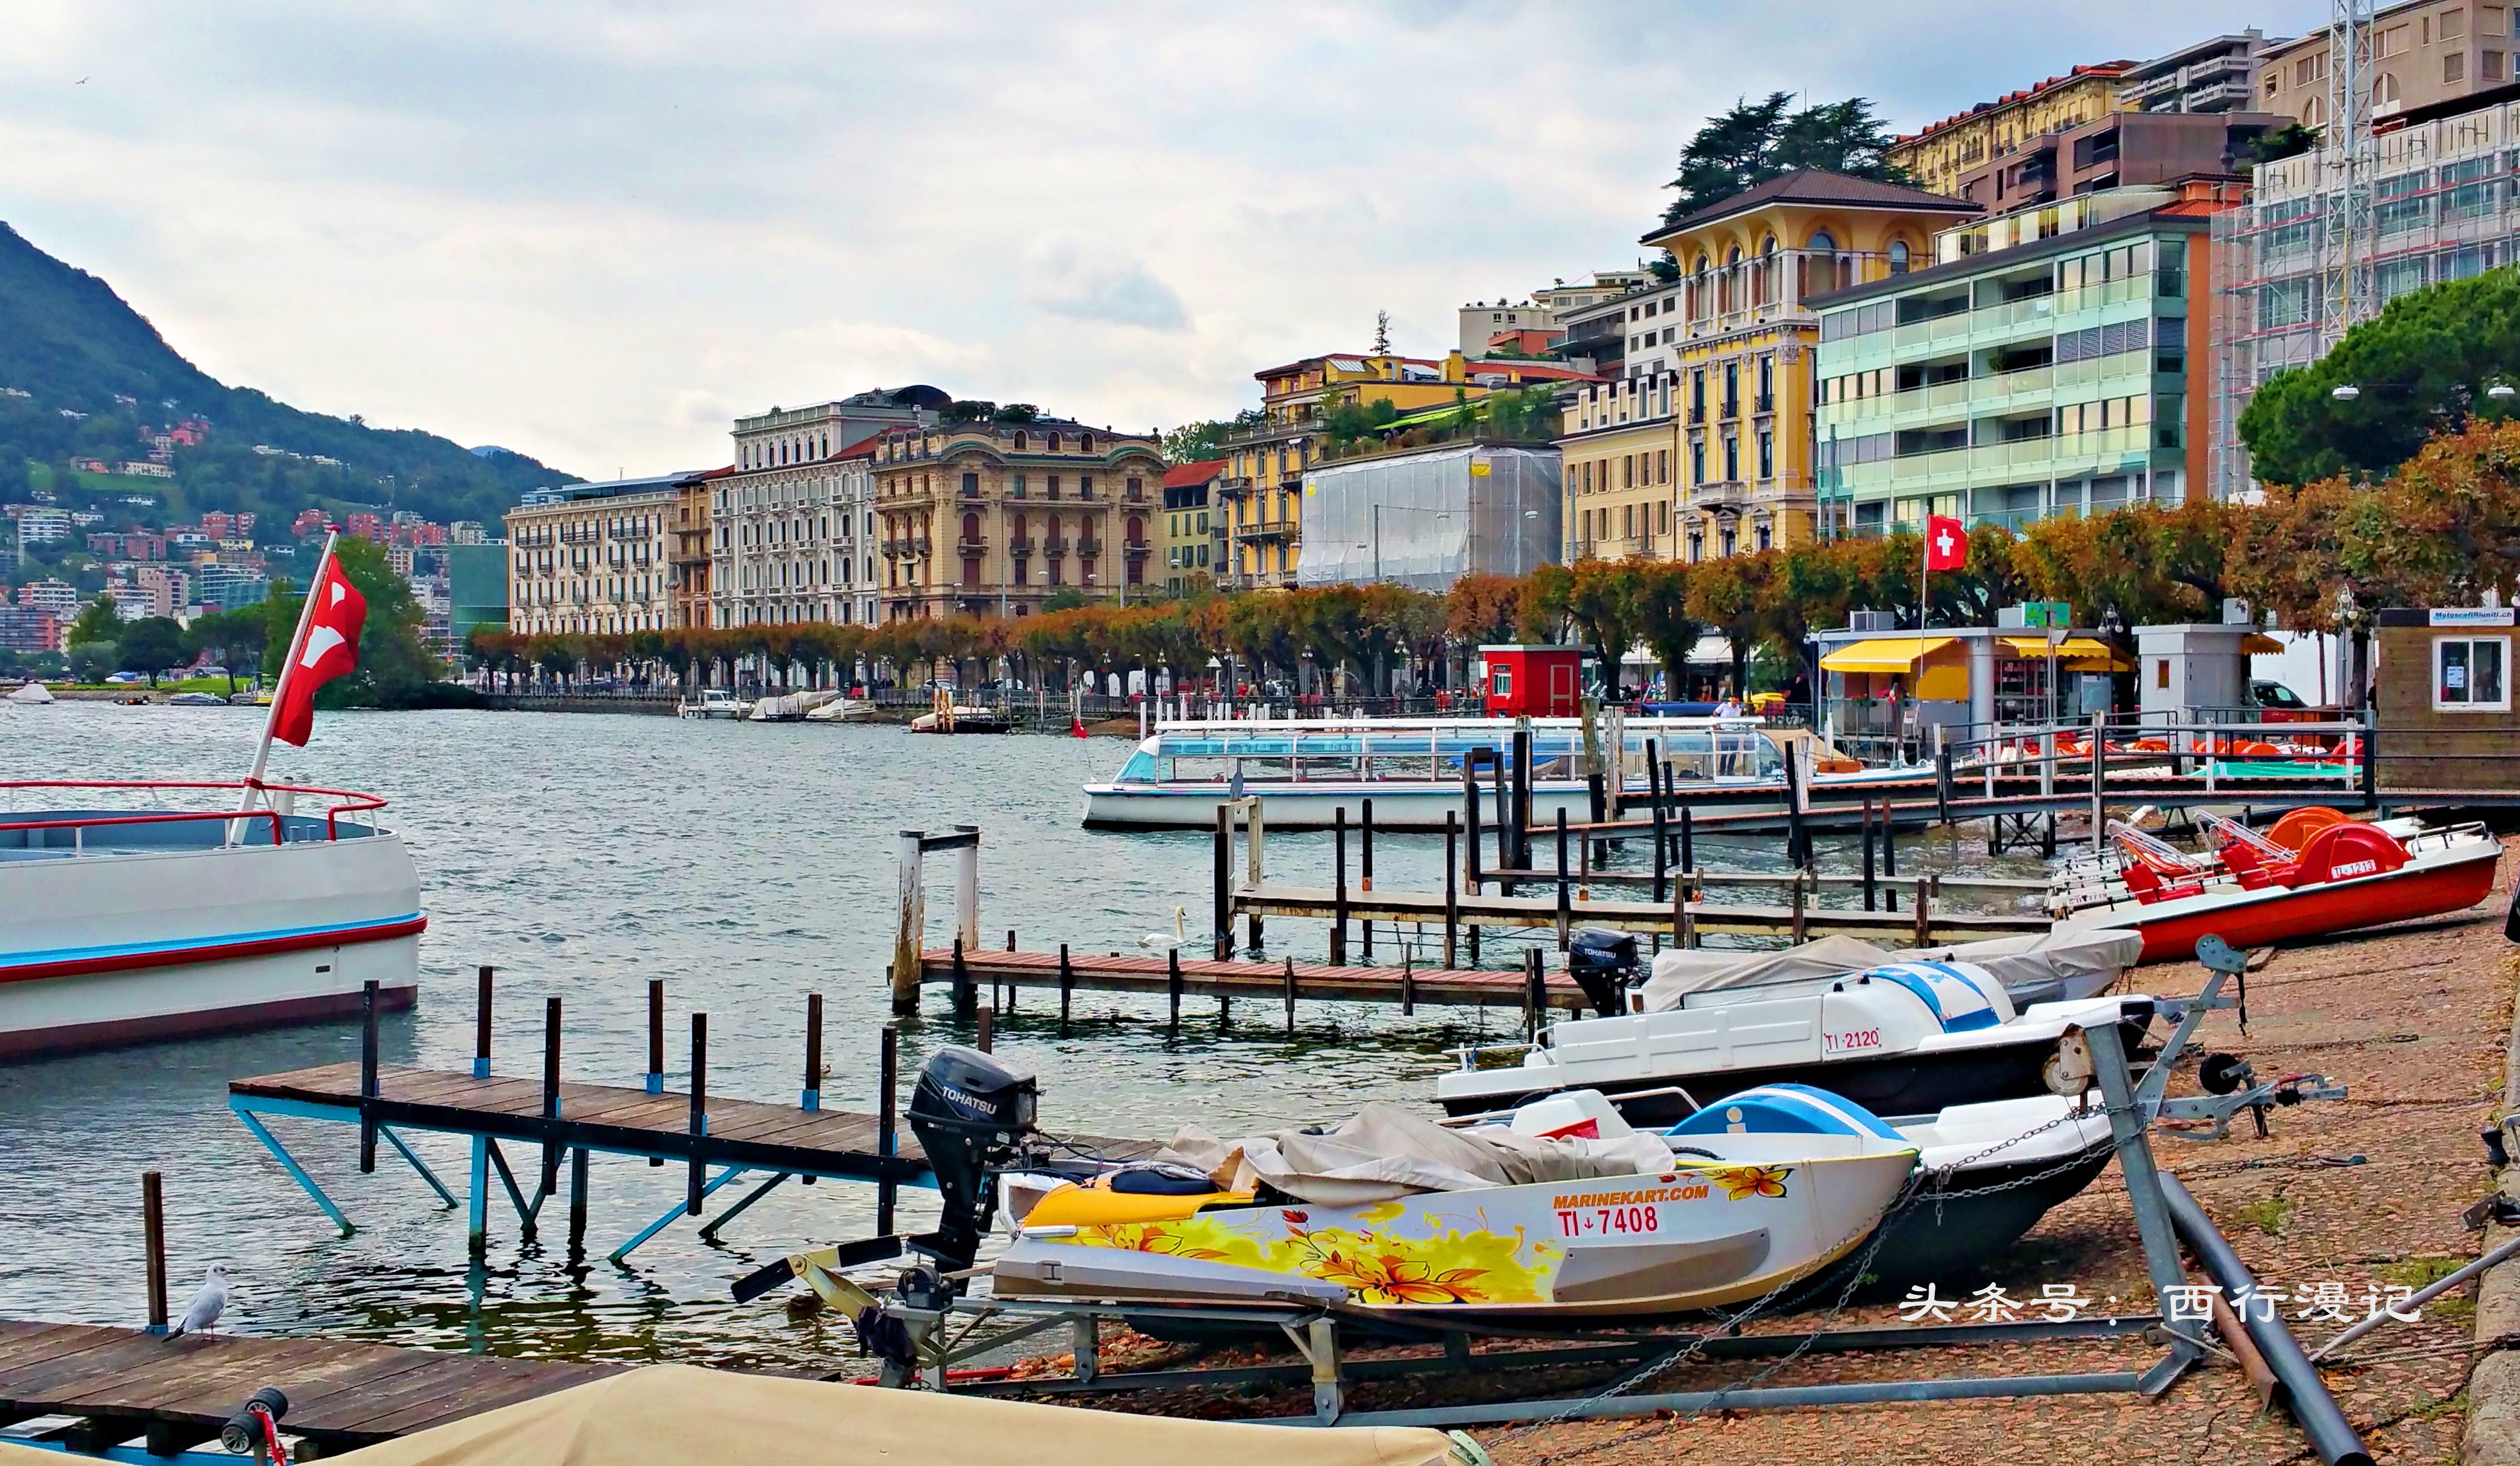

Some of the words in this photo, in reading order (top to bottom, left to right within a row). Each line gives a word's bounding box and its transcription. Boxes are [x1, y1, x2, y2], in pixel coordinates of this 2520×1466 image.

[1584, 947, 1616, 959] TOHATSU
[942, 1086, 997, 1115] TOHATSU
[1553, 1185, 1709, 1209] MARINEKART.COM
